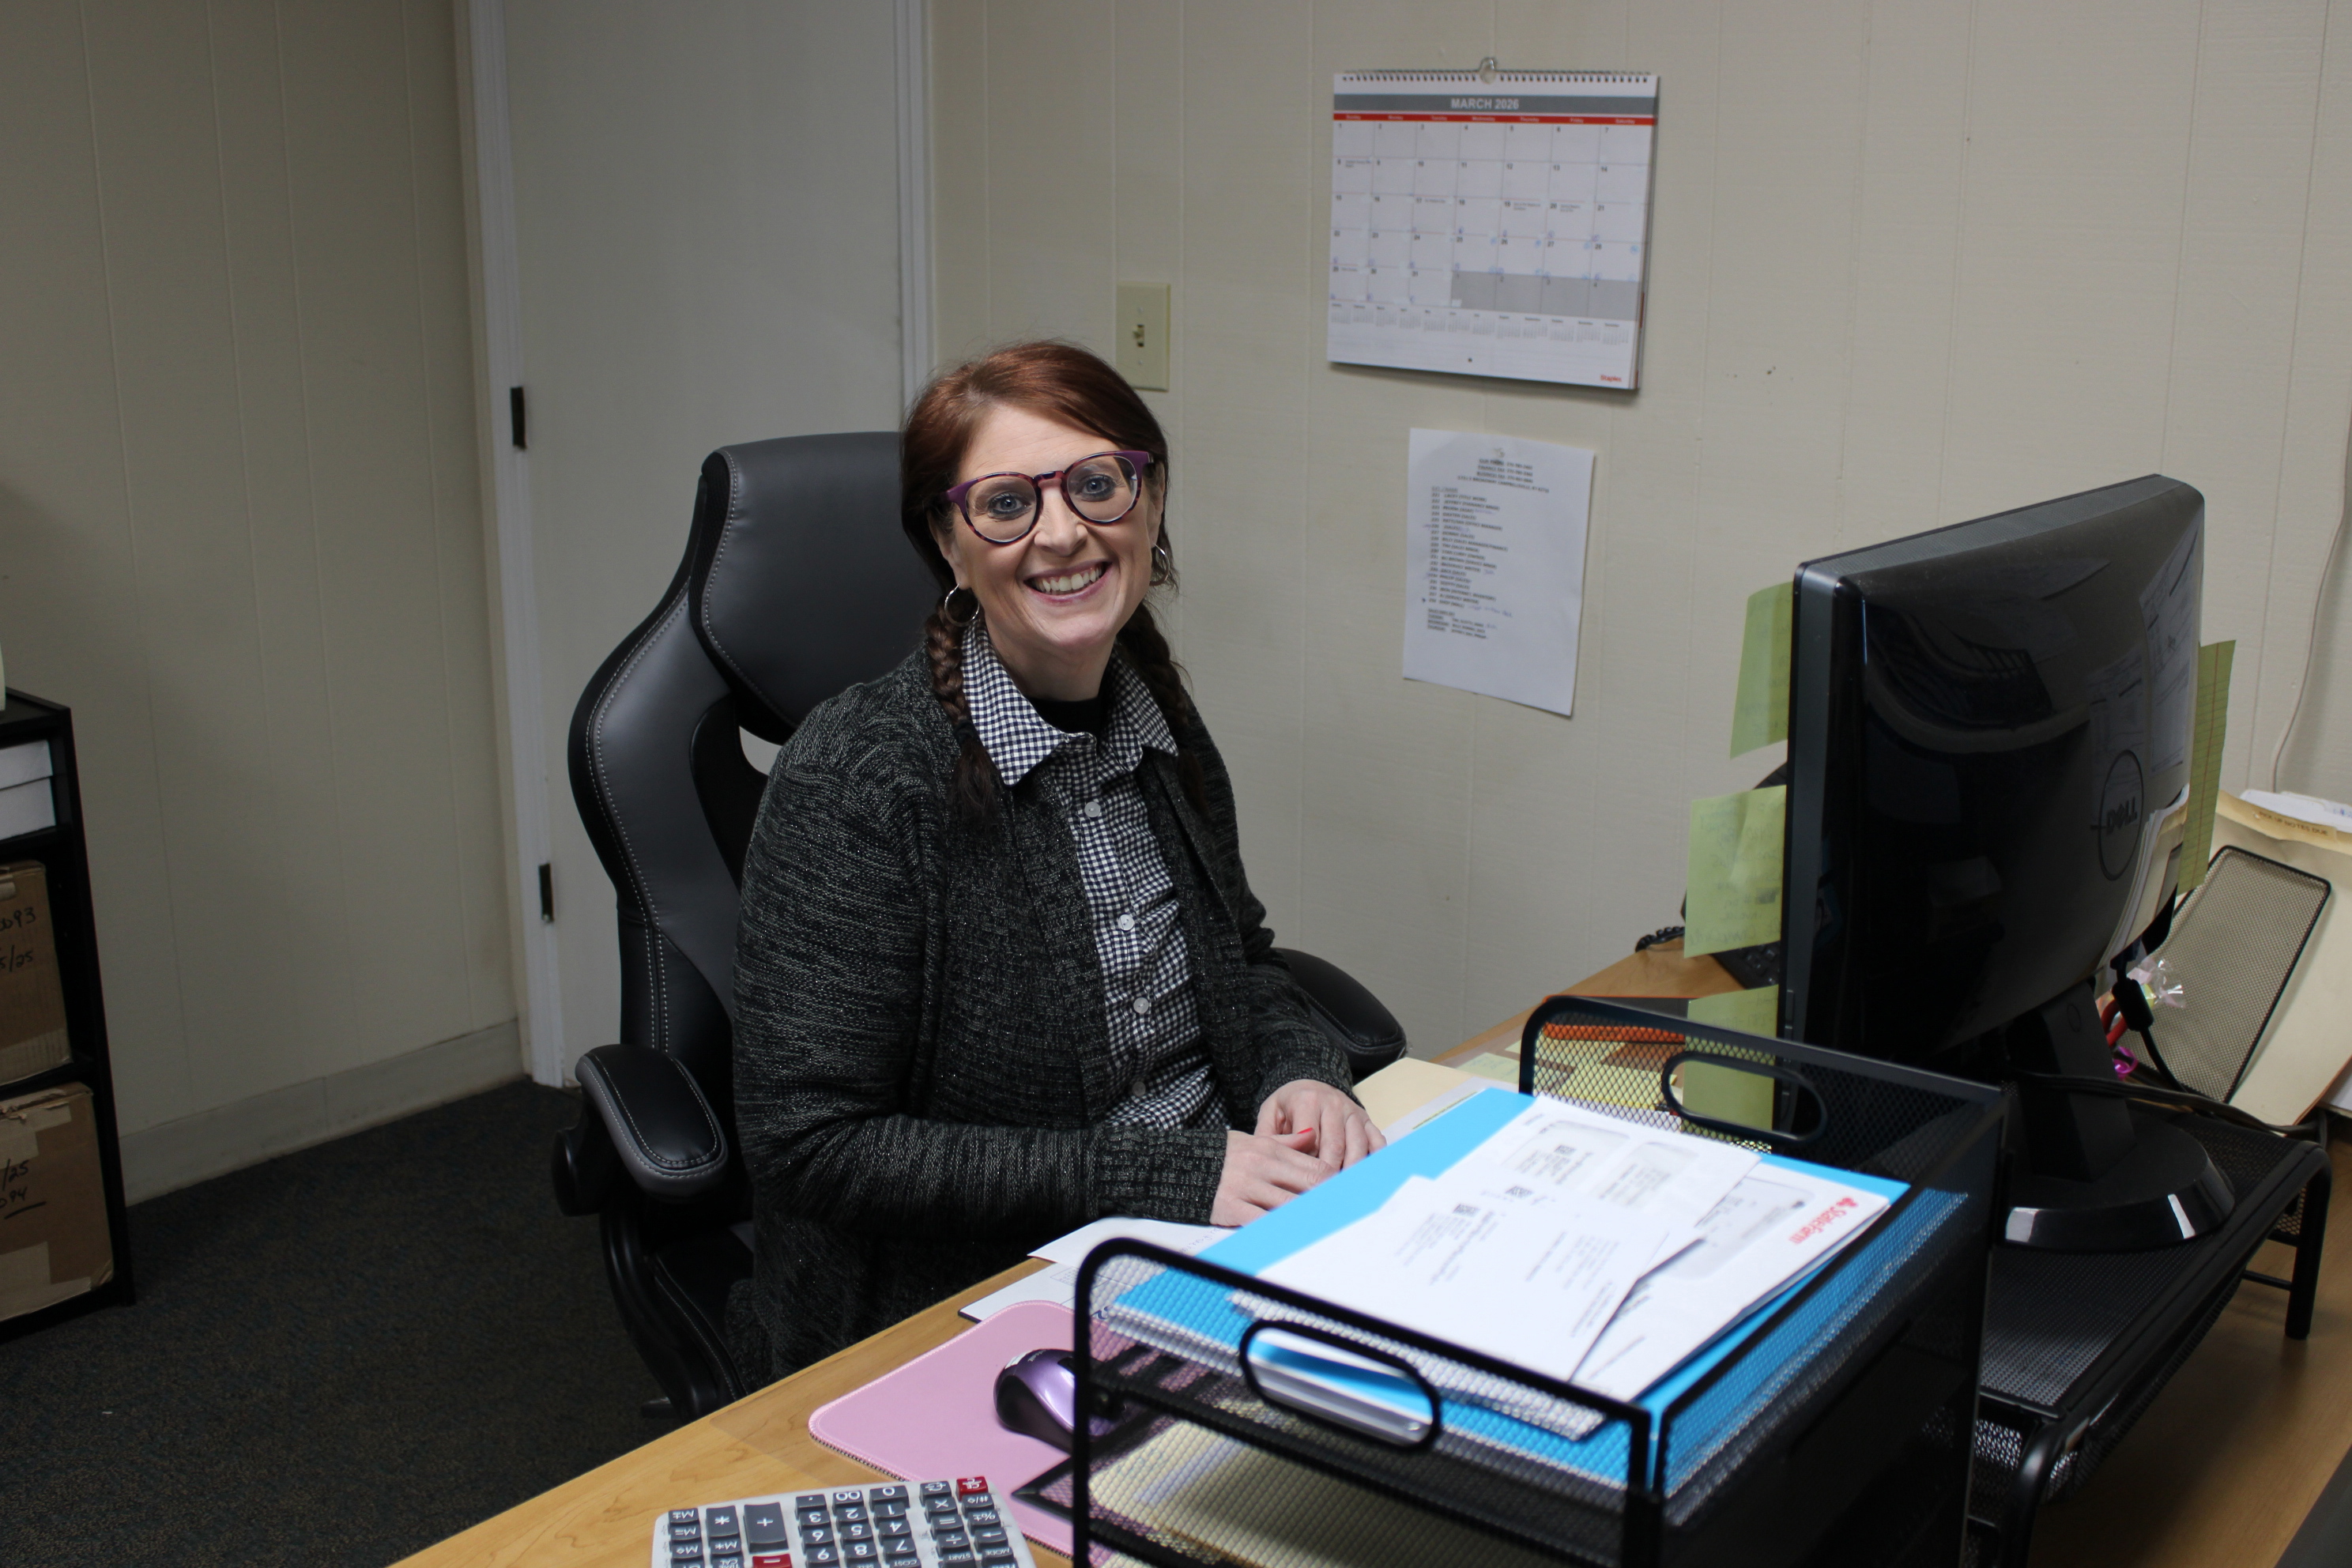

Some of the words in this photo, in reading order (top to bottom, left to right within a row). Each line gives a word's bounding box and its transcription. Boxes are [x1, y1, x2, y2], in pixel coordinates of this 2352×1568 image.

[1450, 98, 1492, 109] MARCH
[1494, 99, 1520, 110] 2026
[2105, 796, 2138, 835] DELL
[2283, 820, 2310, 831] NOTES
[2311, 827, 2328, 835] DUE
[835, 1491, 861, 1501] 00
[882, 1487, 895, 1496] 0
[846, 1508, 859, 1519] 2
[887, 1504, 895, 1515] 1
[809, 1511, 821, 1523] 3
[850, 1524, 863, 1536] 5
[889, 1521, 903, 1533] 4
[812, 1529, 824, 1541] 6
[854, 1543, 868, 1555] 8
[895, 1539, 908, 1551] 7
[817, 1547, 830, 1560] 9
[985, 1547, 1010, 1556] MODE
